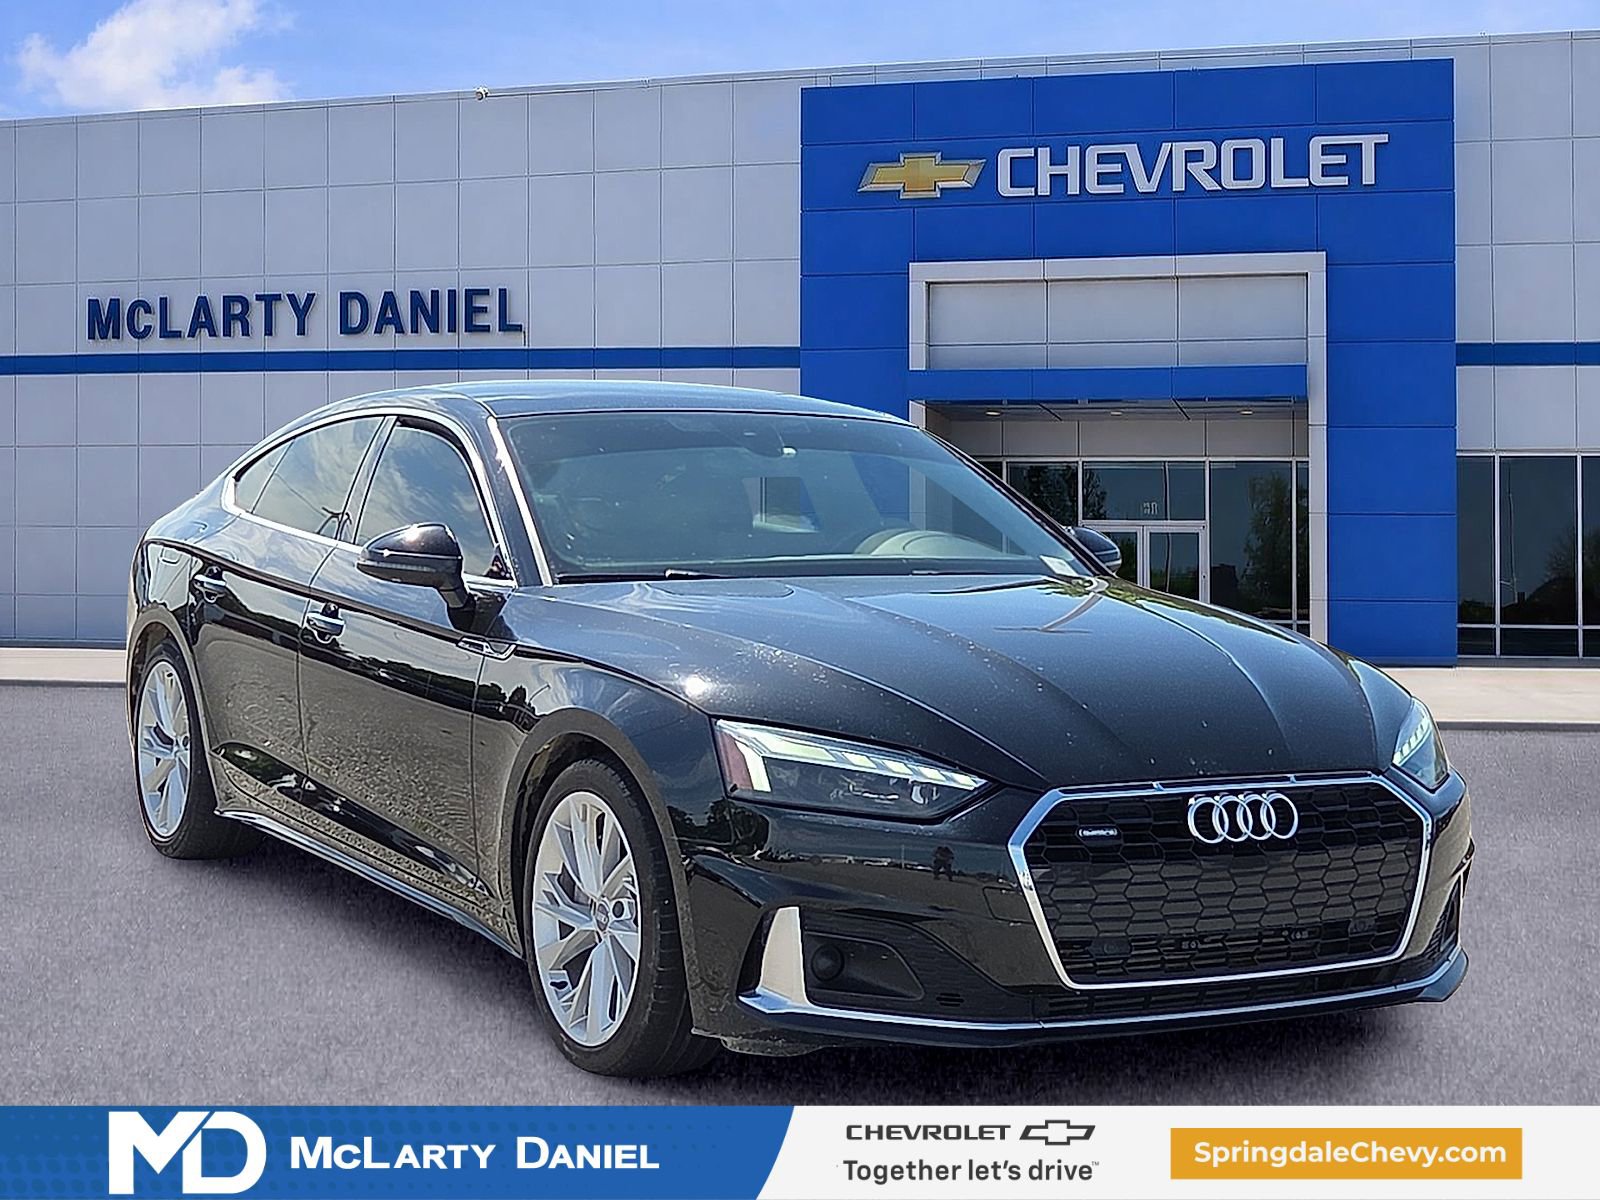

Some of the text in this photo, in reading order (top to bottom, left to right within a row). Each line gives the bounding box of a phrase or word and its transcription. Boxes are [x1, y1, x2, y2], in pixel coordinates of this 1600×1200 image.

[997, 133, 1390, 197] CHEVROLET
[87, 287, 525, 341] MCLARTY DANIEL
